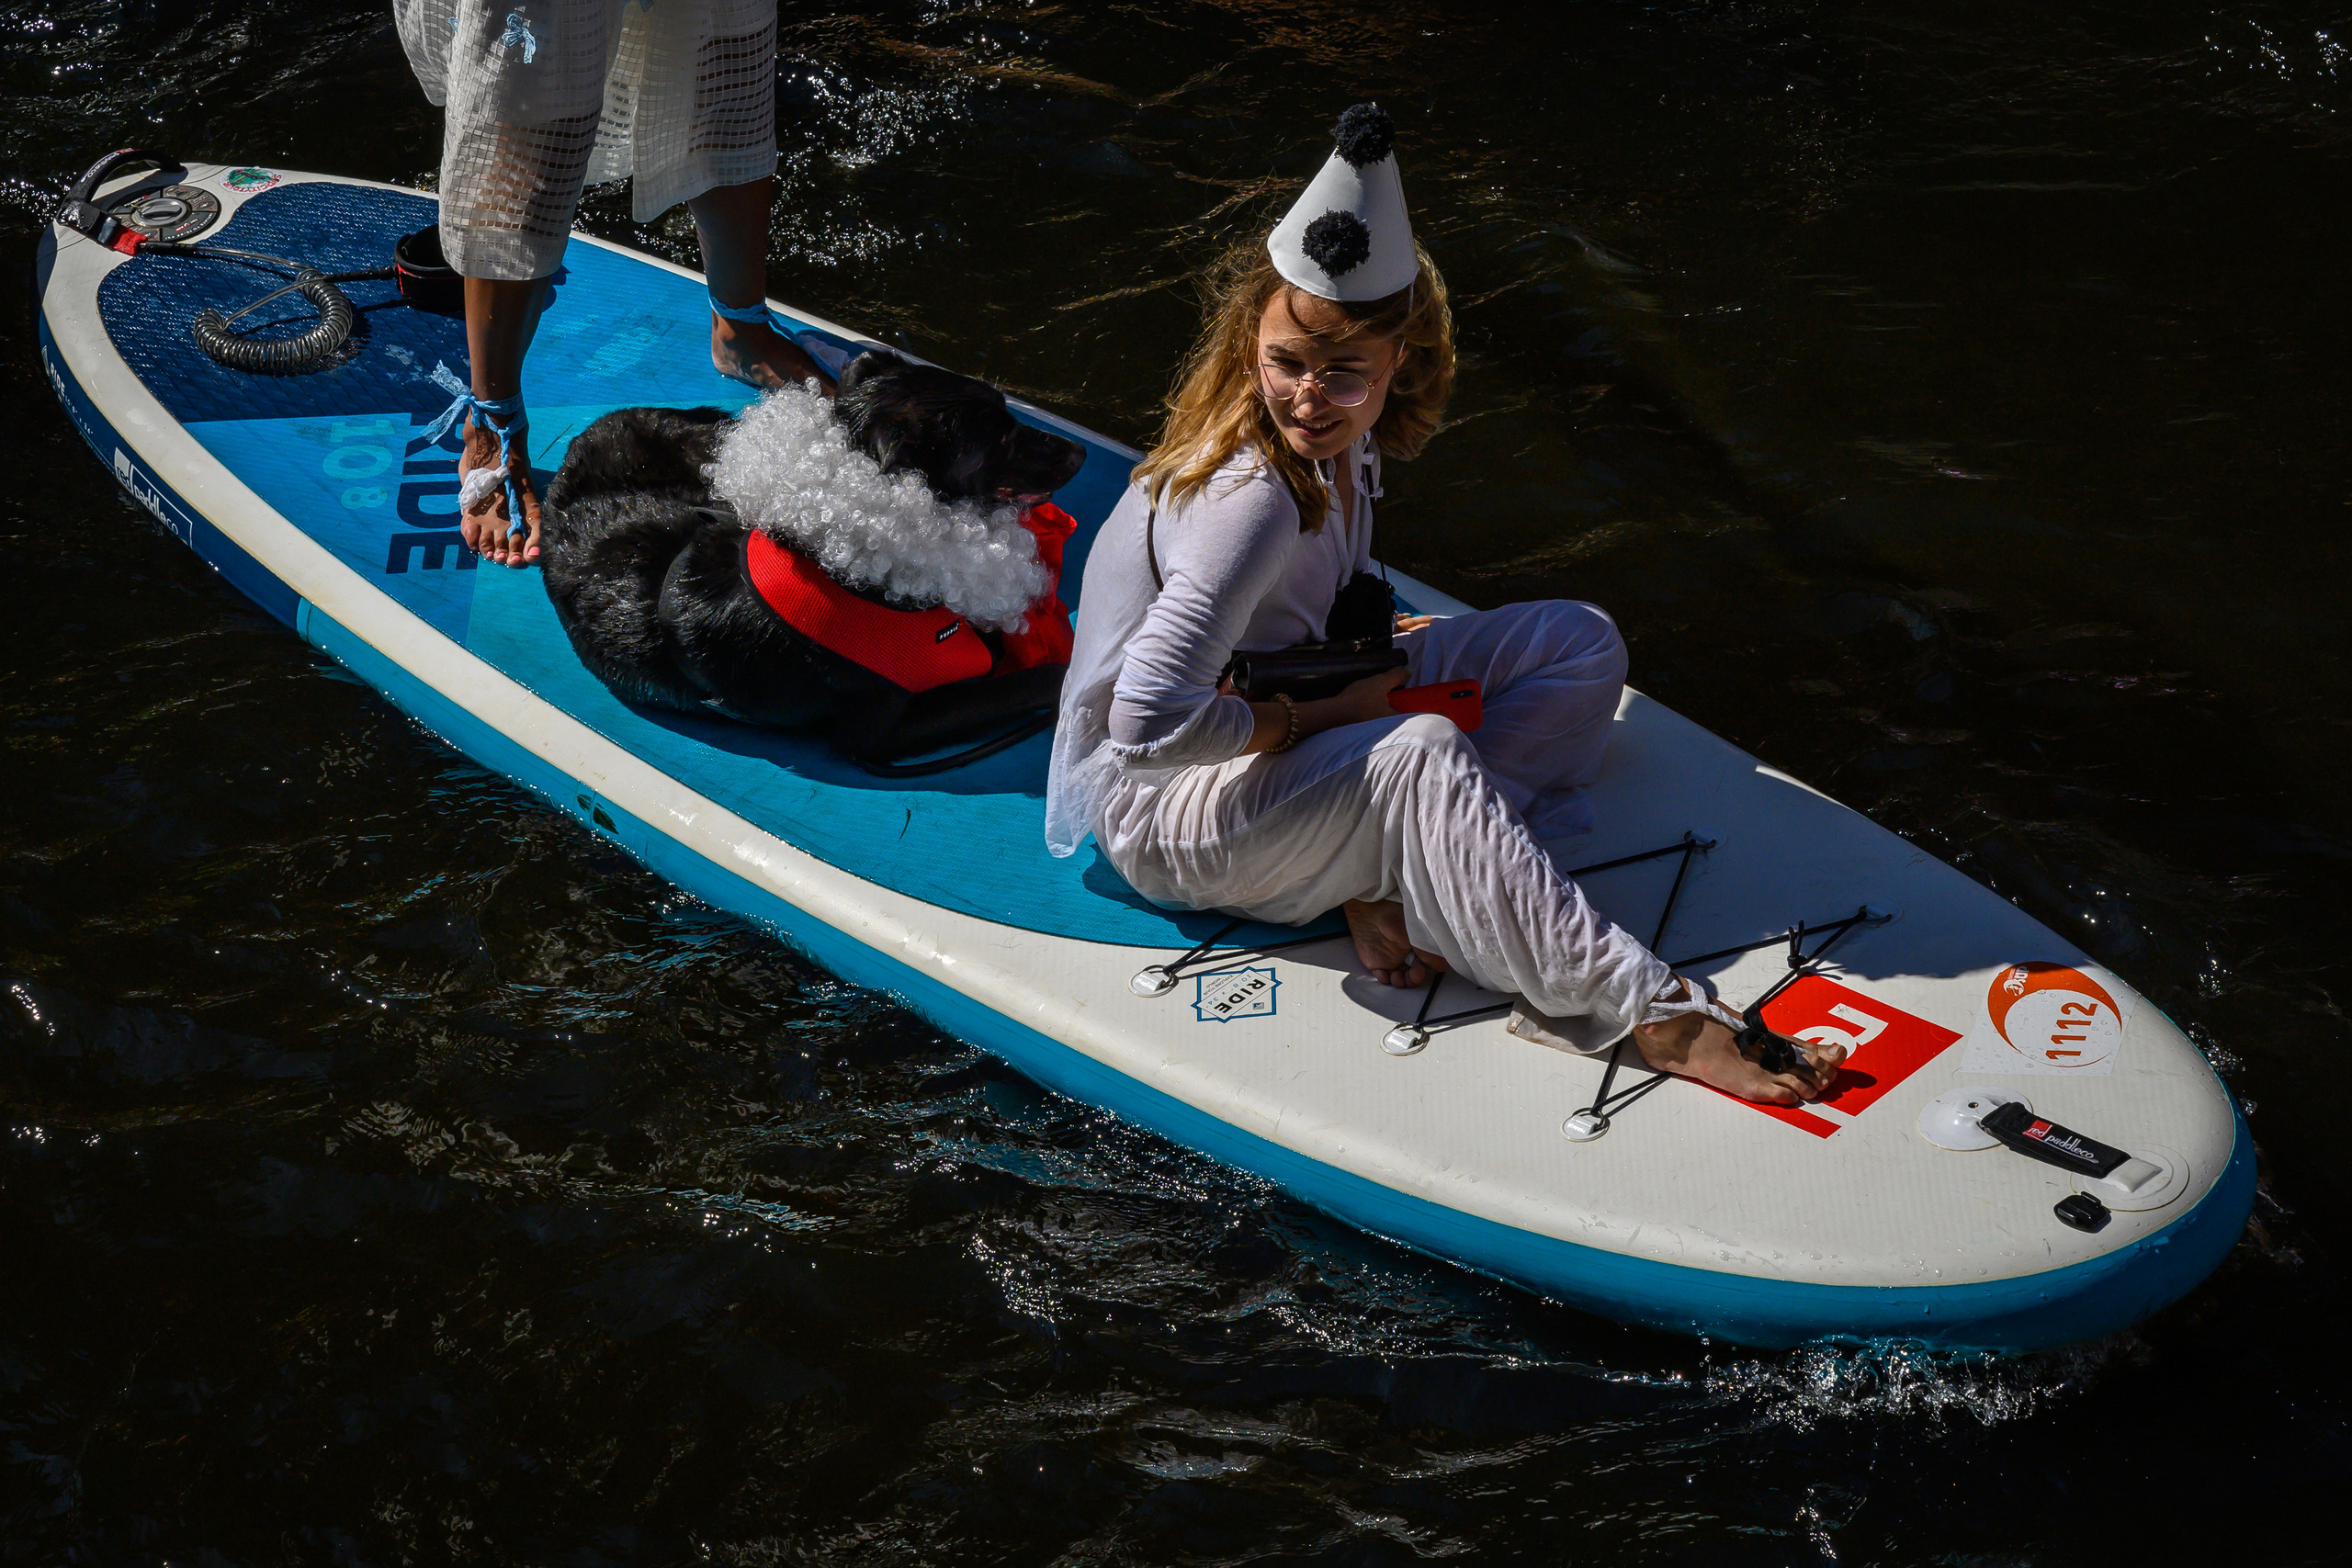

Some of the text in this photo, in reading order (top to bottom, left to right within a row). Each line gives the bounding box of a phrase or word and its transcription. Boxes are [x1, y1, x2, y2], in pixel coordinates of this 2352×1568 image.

[51, 362, 65, 397] RIDE
[386, 412, 479, 574] RIDE
[1213, 978, 1267, 1014] RIDE
[2045, 1002, 2098, 1060] 1112
[2025, 1124, 2095, 1159] red paddleco
